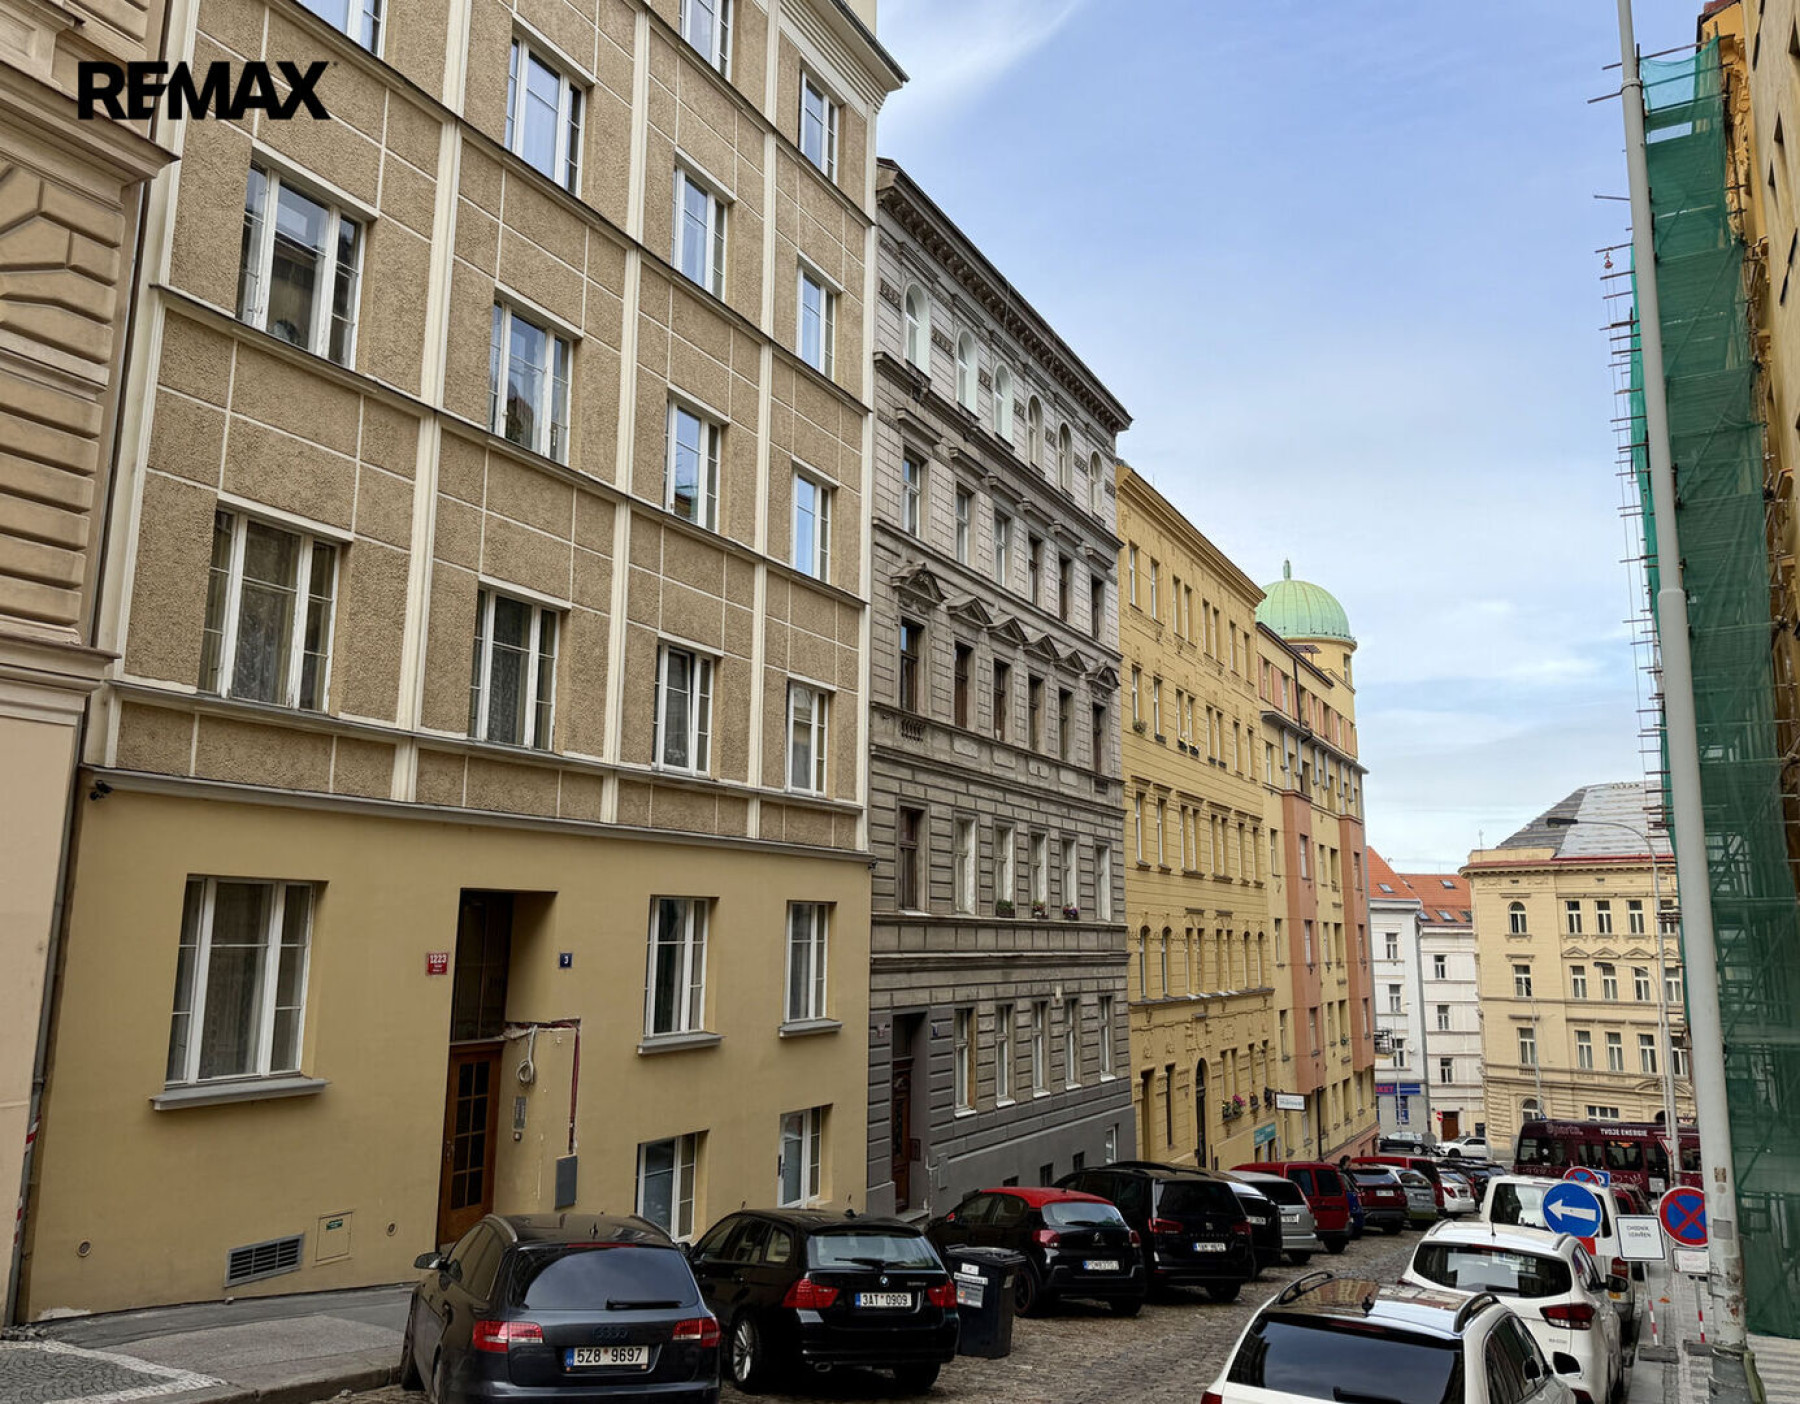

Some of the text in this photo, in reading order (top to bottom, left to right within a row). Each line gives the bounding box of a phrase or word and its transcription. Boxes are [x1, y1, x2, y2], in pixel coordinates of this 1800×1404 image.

[862, 1294, 879, 1305] 3AT
[576, 1347, 643, 1363] 5Z8 9697
